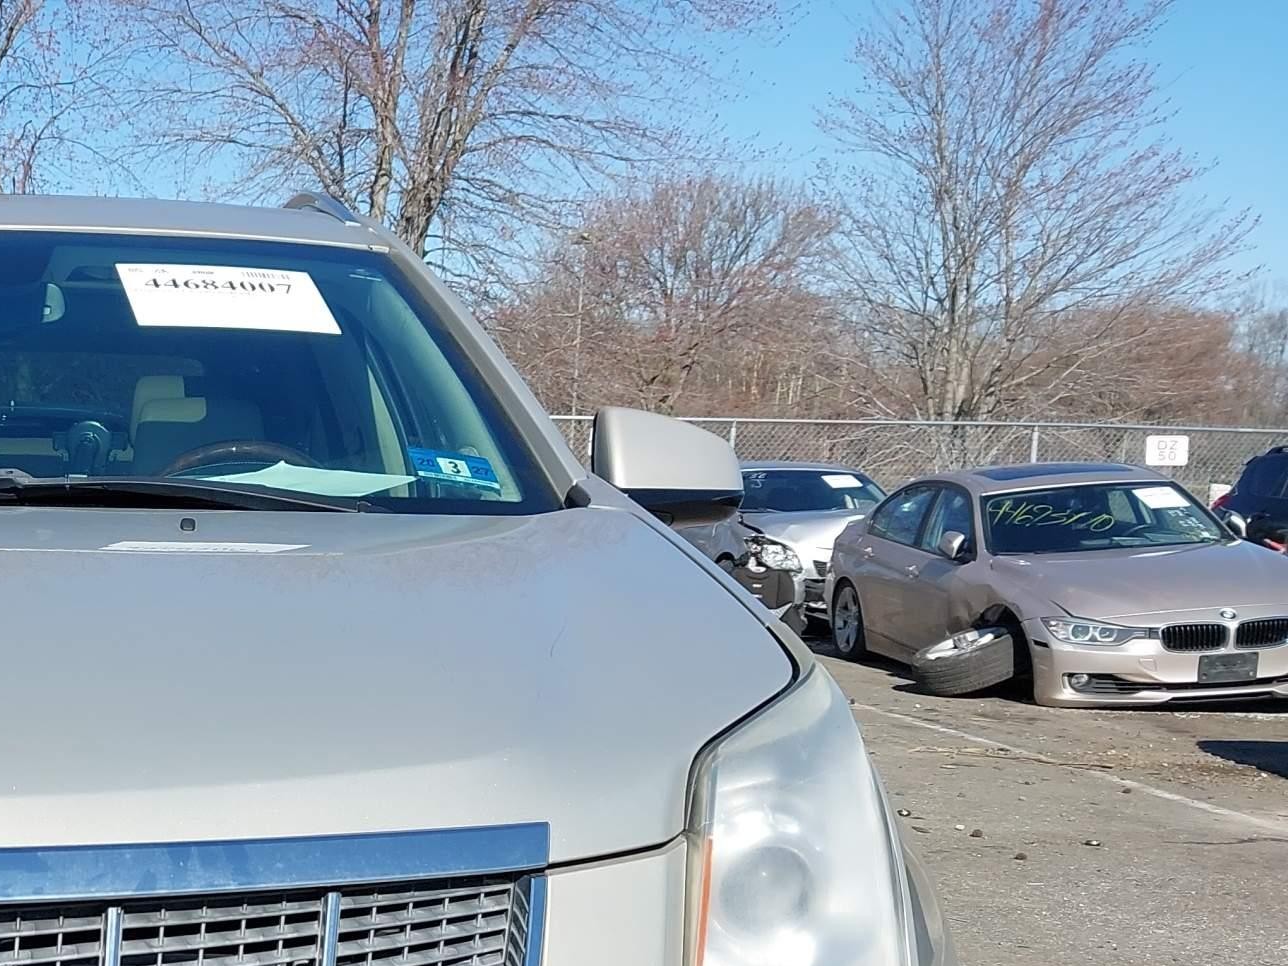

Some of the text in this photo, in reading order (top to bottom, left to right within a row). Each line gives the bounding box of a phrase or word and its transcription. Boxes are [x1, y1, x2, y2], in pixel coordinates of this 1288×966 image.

[144, 277, 292, 294] 44684007
[1158, 451, 1177, 461] 50
[447, 461, 461, 474] 3
